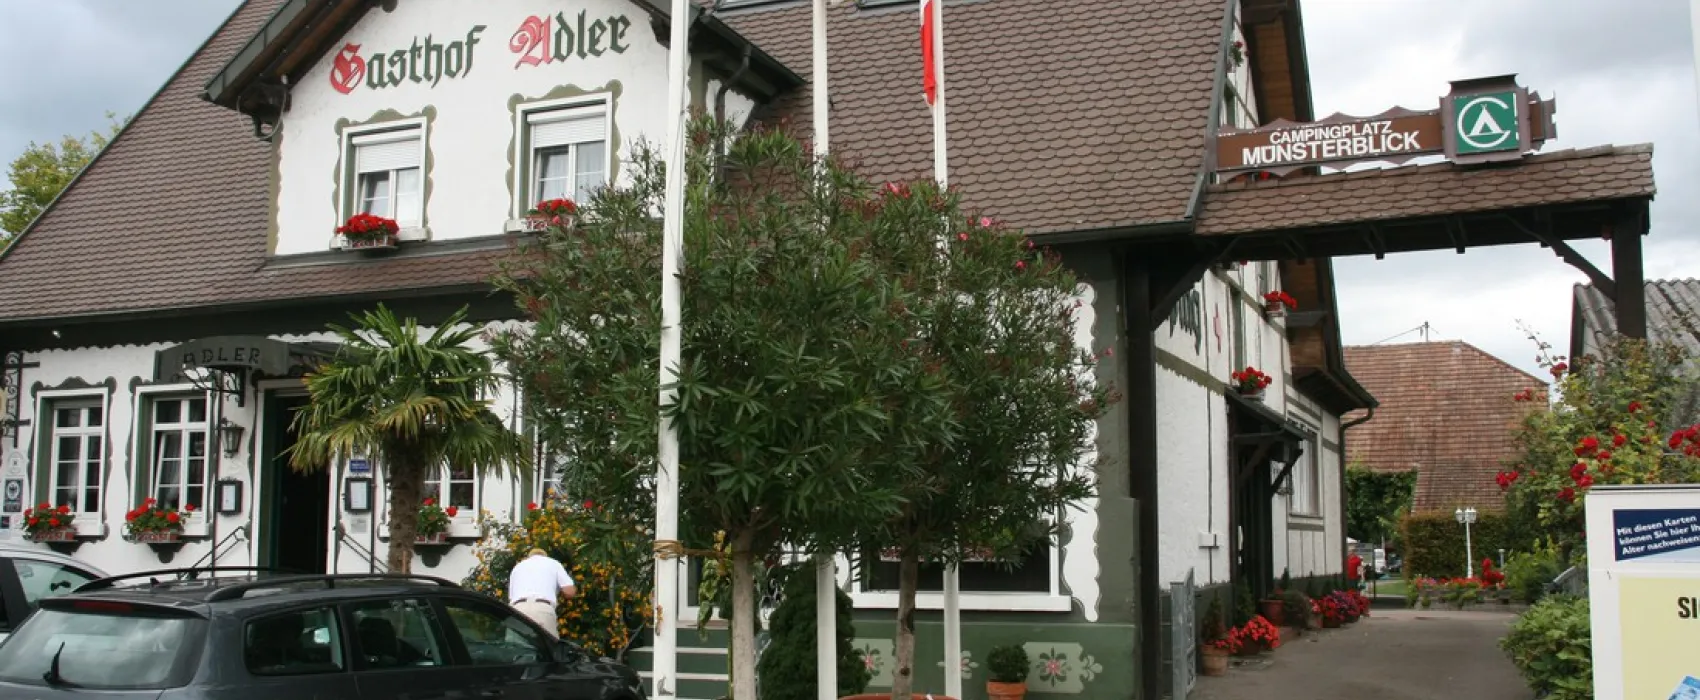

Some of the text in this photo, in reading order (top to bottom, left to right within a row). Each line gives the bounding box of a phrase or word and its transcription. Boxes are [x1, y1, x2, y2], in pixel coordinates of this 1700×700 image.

[330, 9, 631, 94] Gasthof Adler
[1269, 120, 1392, 145] CAMPINGPLATZ
[1242, 131, 1421, 165] MÜNSTERBLICK
[184, 347, 260, 365] ADLER
[1616, 515, 1697, 535] Mit diesen Karten
[1619, 534, 1652, 545] können
[1654, 530, 1669, 540] Sie
[1670, 527, 1689, 536] hier
[1622, 545, 1646, 555] Alter
[1677, 596, 1700, 619] SI
